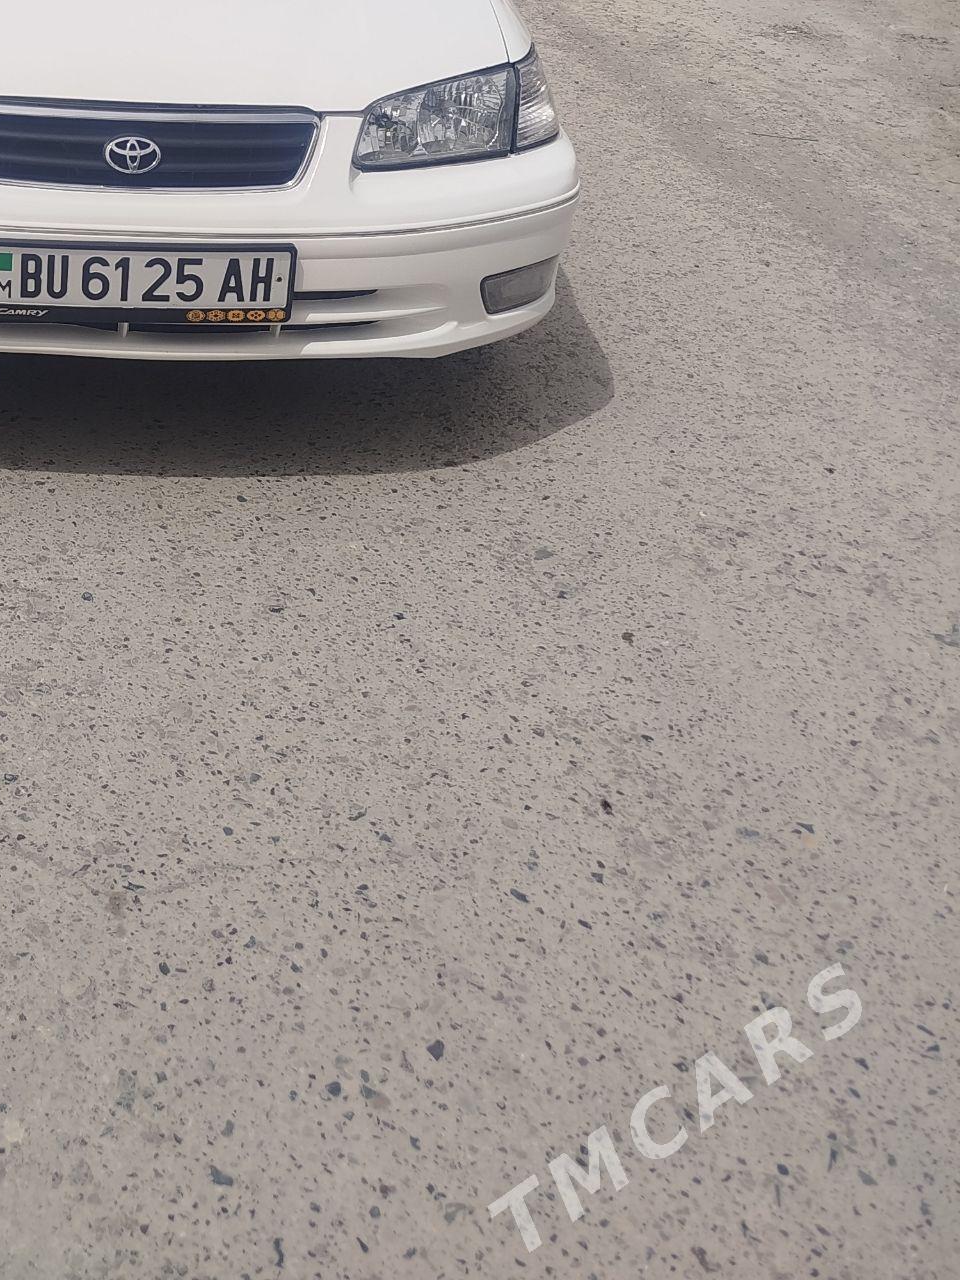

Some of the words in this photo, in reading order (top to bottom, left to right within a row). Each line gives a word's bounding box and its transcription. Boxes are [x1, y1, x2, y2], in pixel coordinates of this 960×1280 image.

[20, 253, 69, 299] BU
[81, 256, 204, 302] 6125
[217, 257, 275, 302] AH
